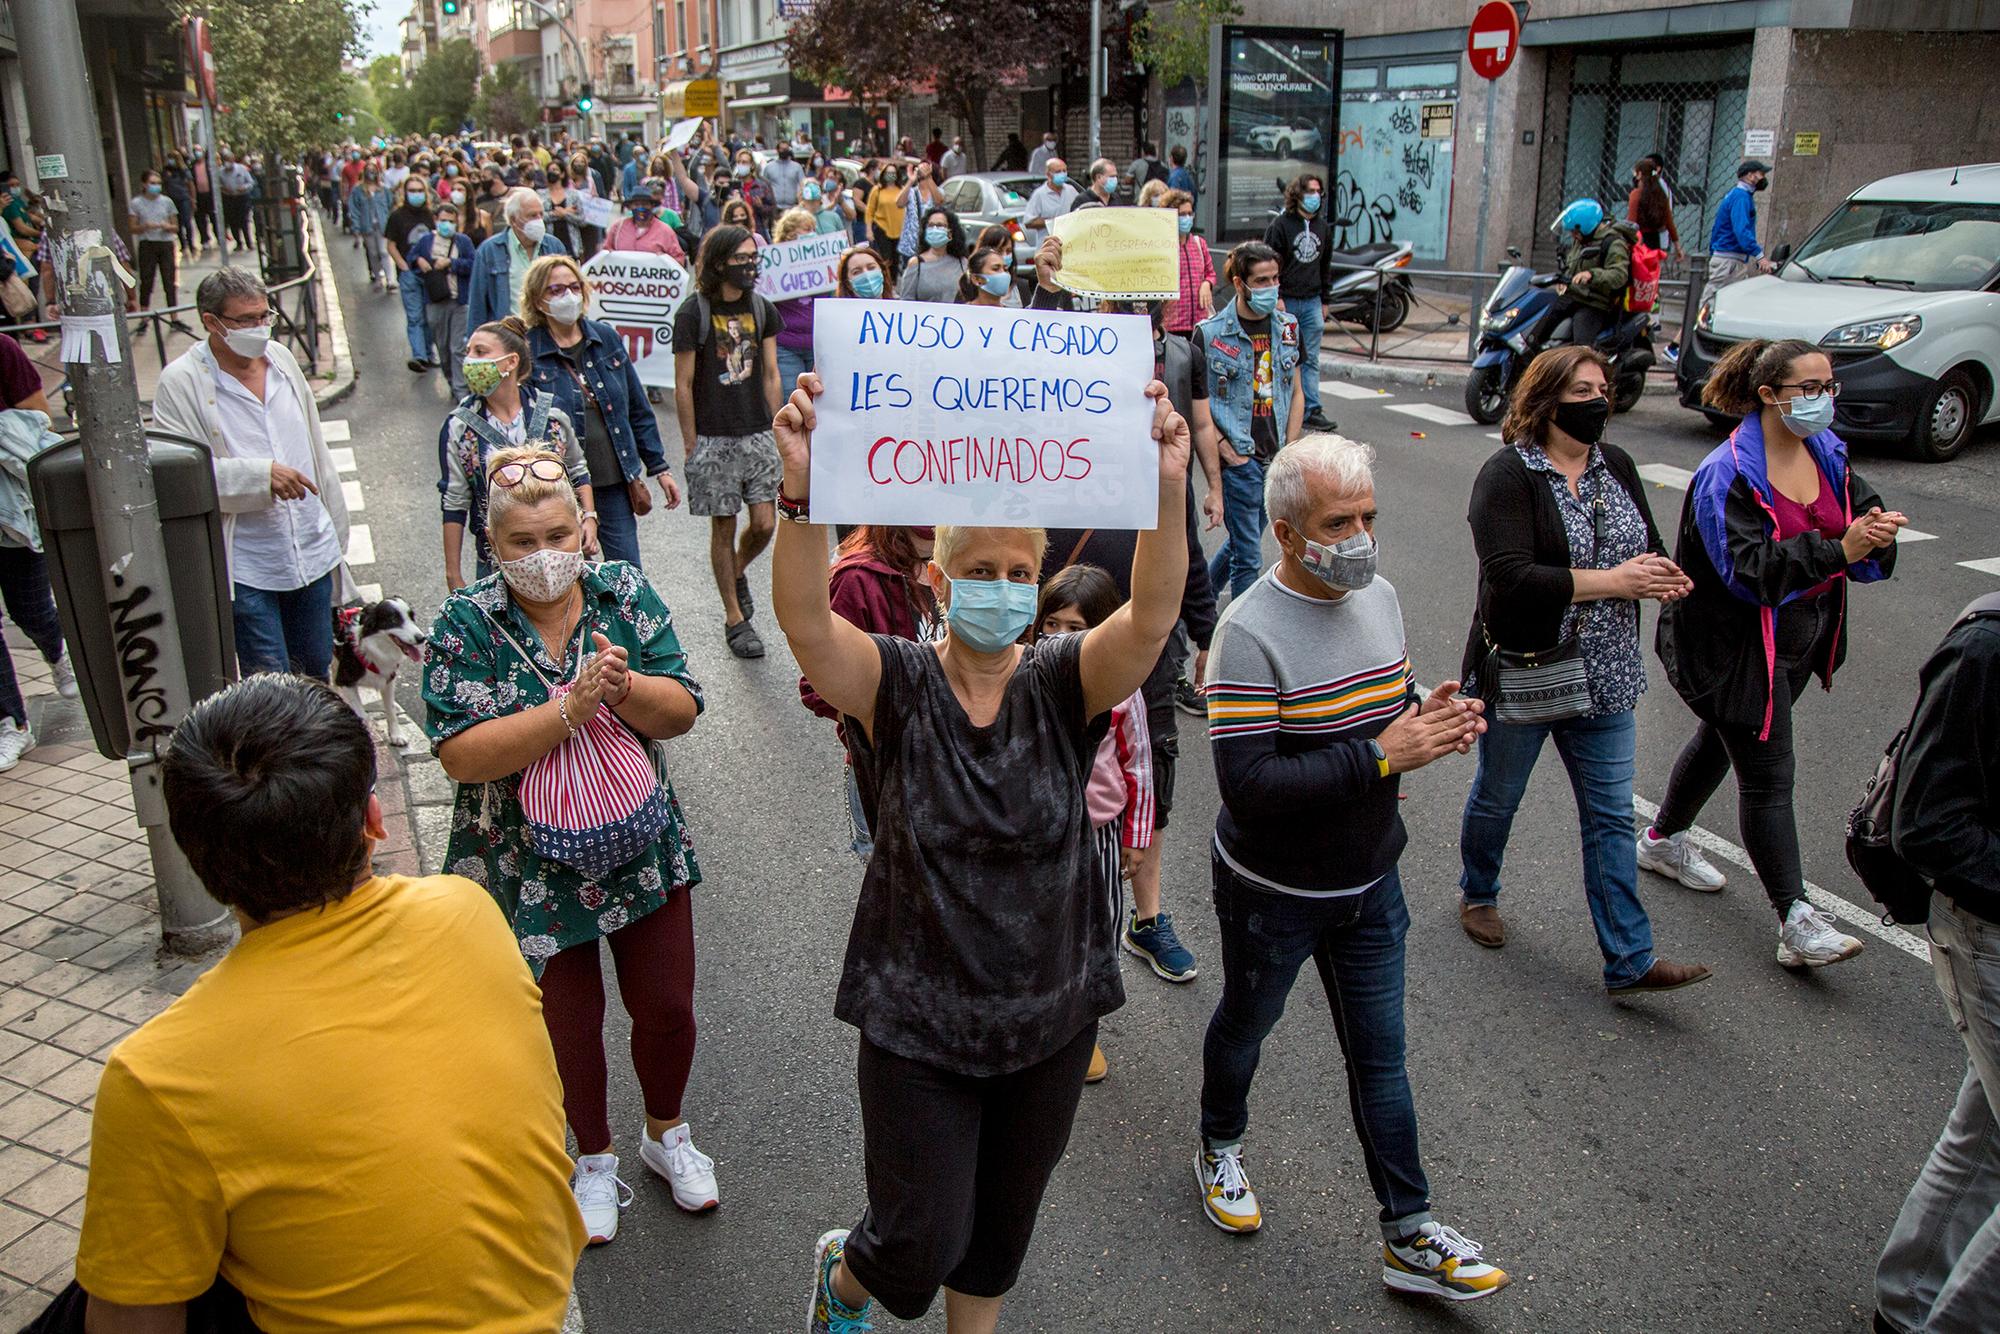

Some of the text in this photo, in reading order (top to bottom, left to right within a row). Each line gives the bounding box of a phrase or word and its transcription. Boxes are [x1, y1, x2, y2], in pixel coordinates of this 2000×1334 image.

[1233, 73, 1288, 81] Nuevo CAPTUR
[1266, 82, 1313, 92] ENCHUFABLE
[1430, 106, 1452, 118] ALQUILA
[630, 266, 681, 280] BARRIO
[780, 269, 824, 292] GUETO
[859, 311, 964, 349] AYUSO
[1009, 318, 1118, 356] CASADO
[850, 372, 1112, 414] LES QUEREMOS
[867, 436, 1092, 485] CONFINADOS
